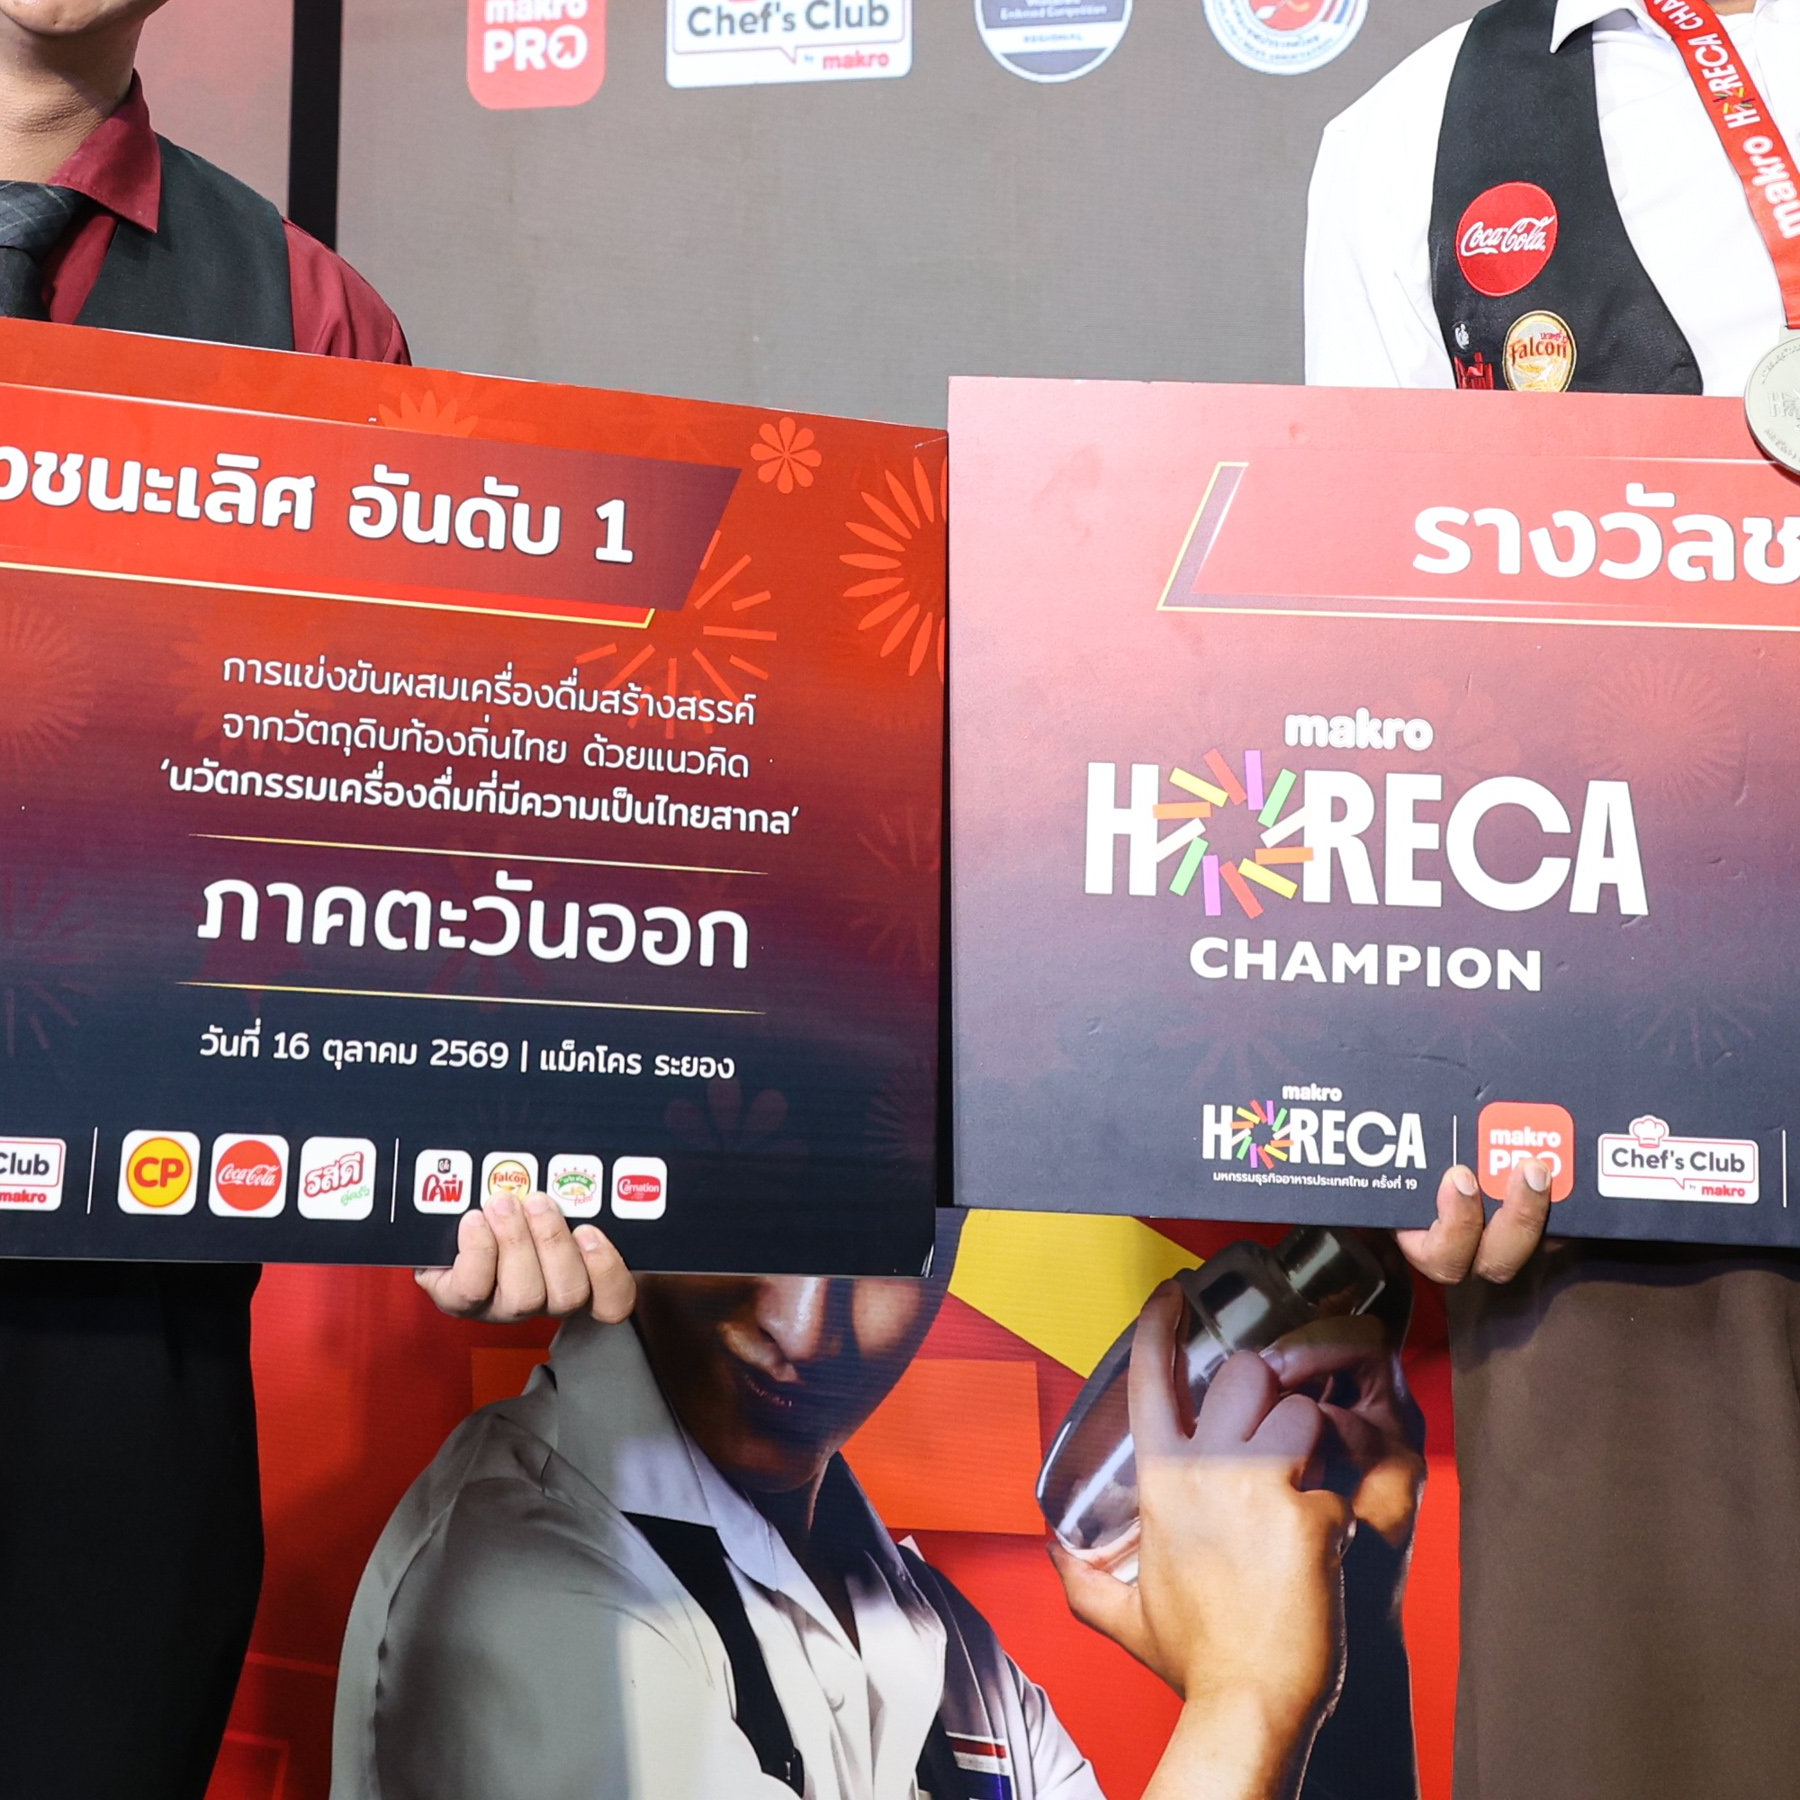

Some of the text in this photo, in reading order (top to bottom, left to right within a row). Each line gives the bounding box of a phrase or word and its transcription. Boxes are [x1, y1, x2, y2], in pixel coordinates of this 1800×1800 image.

[687, 5, 796, 37] Chef's
[483, 24, 588, 72] PRO
[823, 50, 889, 70] makro
[1687, 33, 1761, 129] HORECA
[1460, 215, 1557, 257] Coca-Cola
[1509, 337, 1567, 366] Falcon
[347, 462, 561, 555] อันดับ
[596, 500, 634, 563] 1
[222, 654, 755, 726] การแข่งขันผสมเครื่องดื่มสร้างสรรค์
[221, 709, 749, 779] จากวัตถุดิบท้องถิ่นไทย ด้วยแนวคิด
[1284, 707, 1434, 751] makro
[1084, 747, 1651, 920] HORECA
[196, 869, 750, 970] ภาคตะวันออก
[1189, 936, 1542, 992] CHAMPION
[200, 1018, 735, 1079] วันที่ 16 ตุลาคม 2569 แม็คโคร ระยอง
[1282, 1083, 1342, 1102] makro
[1202, 1099, 1427, 1169] HORECA
[1490, 1126, 1561, 1148] makro
[133, 1156, 184, 1188] CP
[217, 1162, 279, 1189] Coca-Cola
[303, 1151, 364, 1198] รสดี
[492, 1170, 527, 1186] Falcon
[1611, 1147, 1744, 1173] Chef's Club
[619, 1178, 659, 1195] Carnation
[1701, 1185, 1745, 1198] makro
